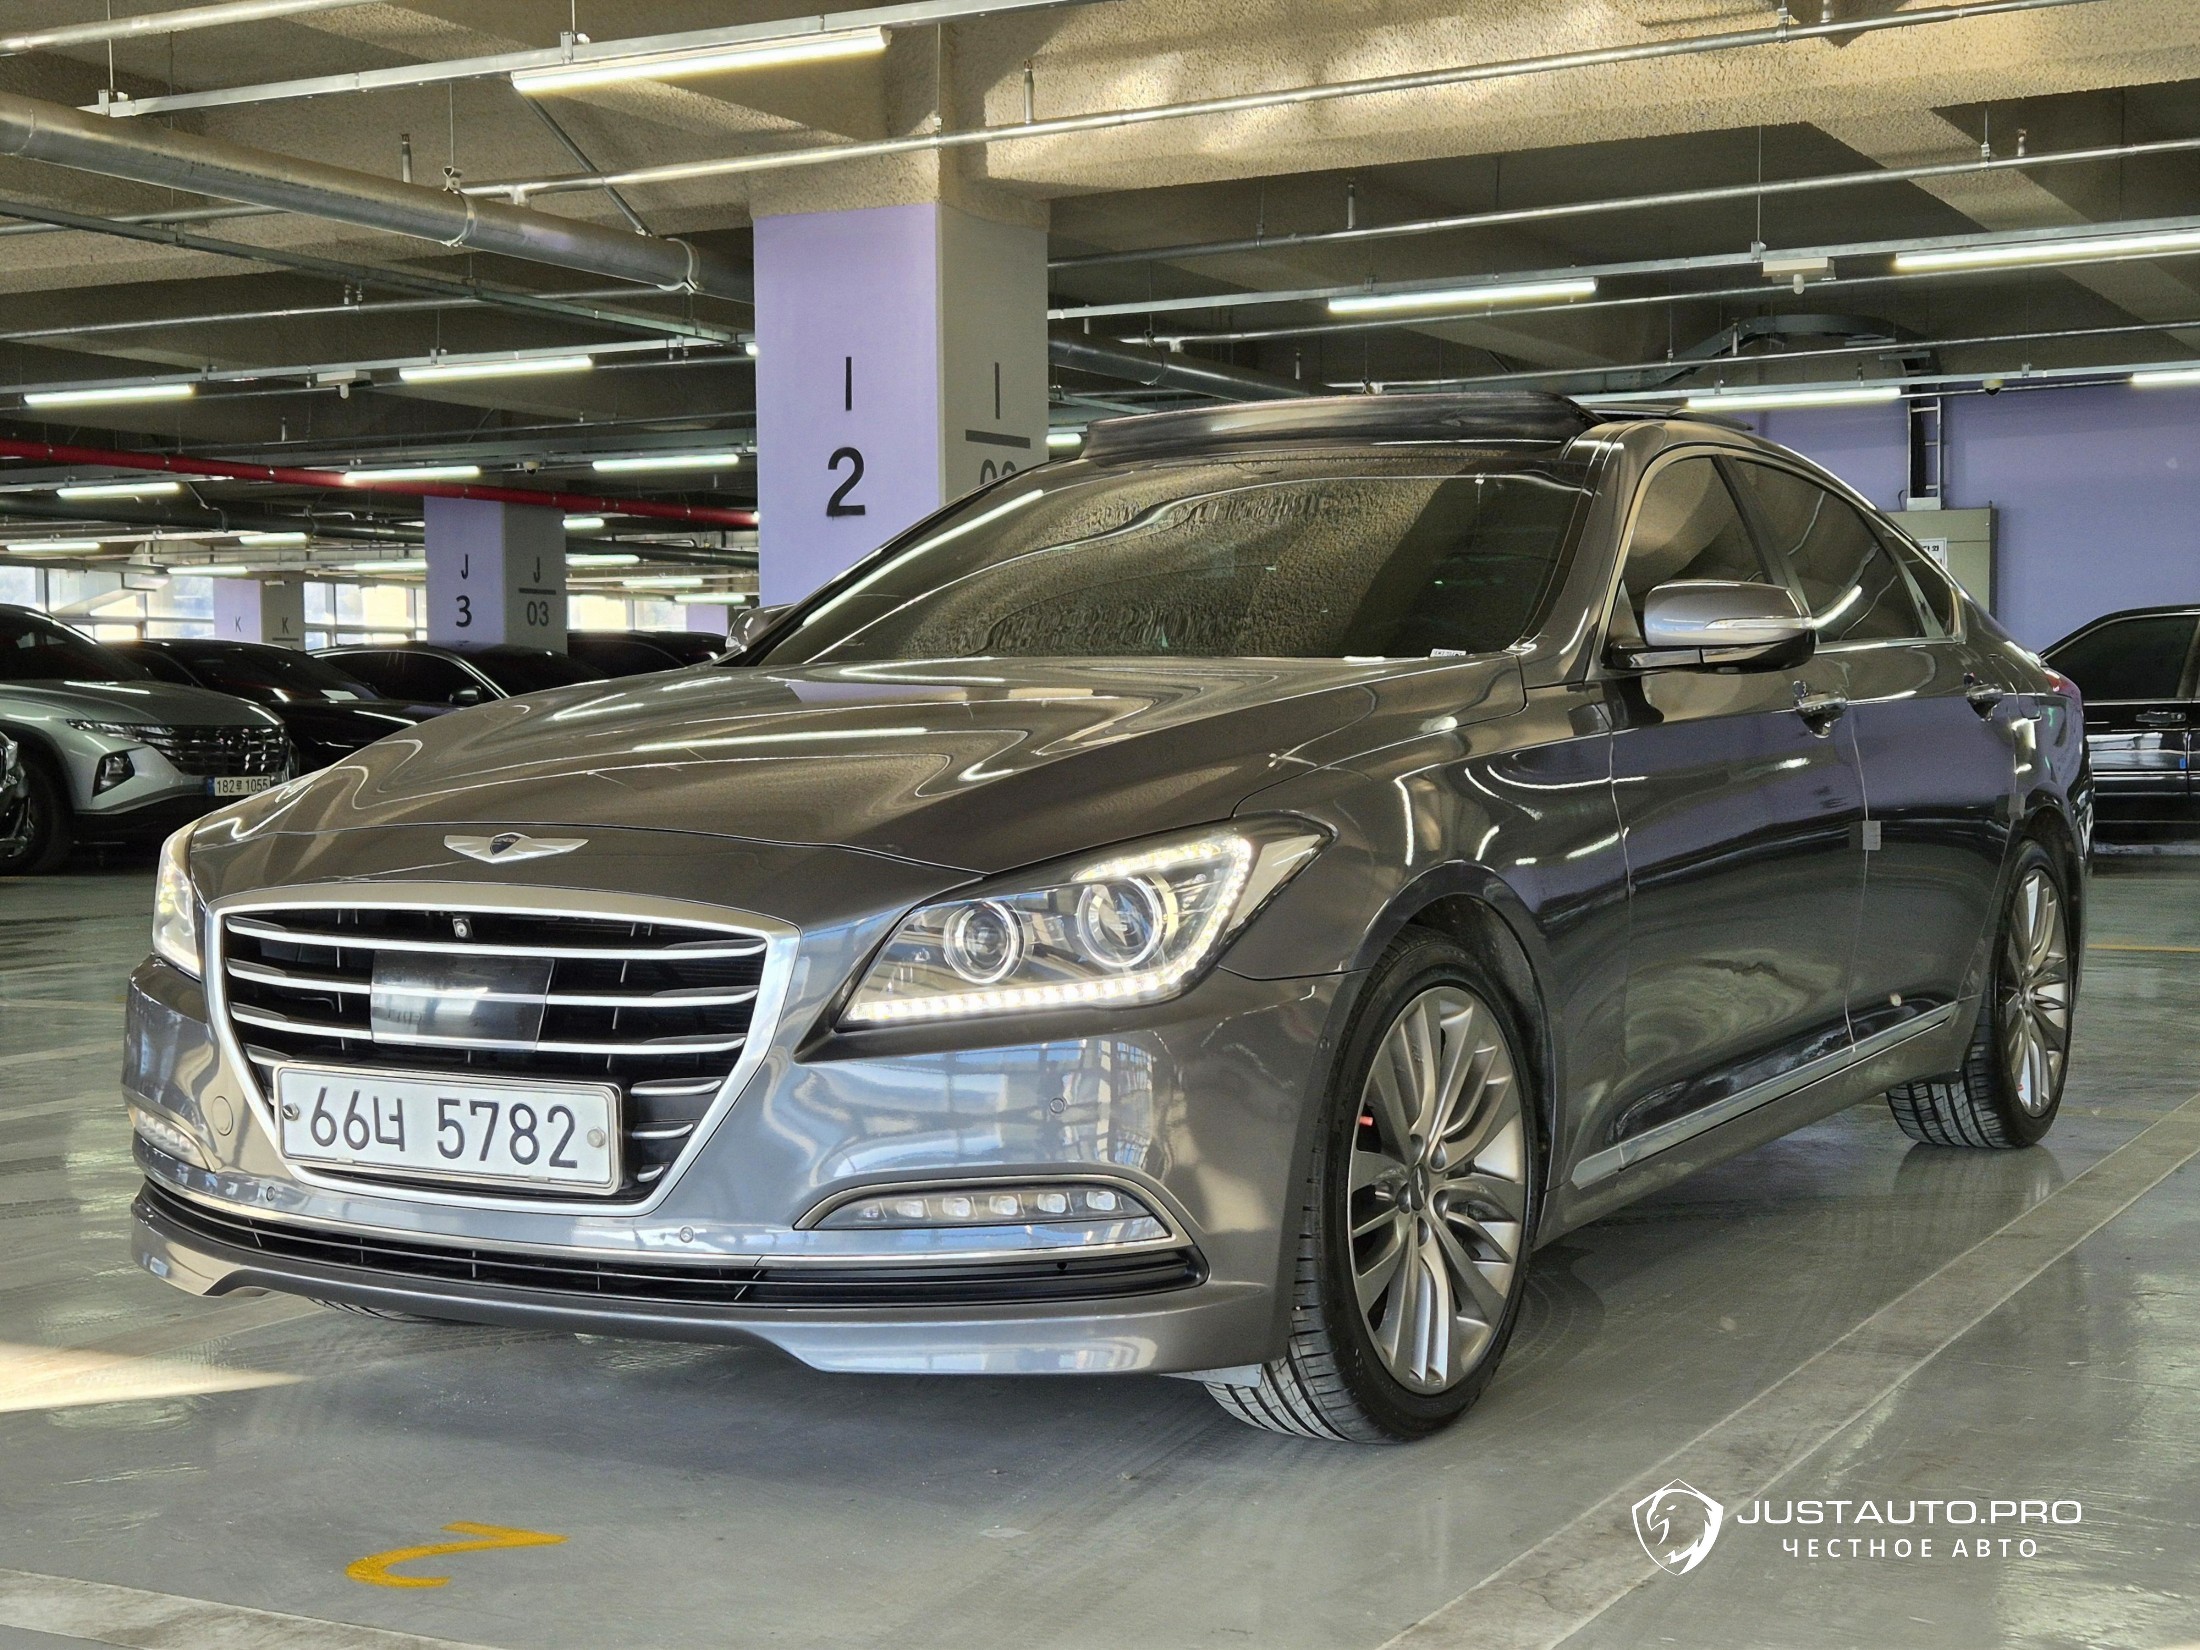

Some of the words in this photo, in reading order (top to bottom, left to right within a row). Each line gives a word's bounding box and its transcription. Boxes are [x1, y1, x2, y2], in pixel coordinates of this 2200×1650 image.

[826, 447, 865, 516] 2
[461, 554, 468, 579] J
[533, 557, 540, 583] J
[235, 616, 242, 632] K
[456, 595, 472, 627] 3
[526, 601, 549, 627] 03
[282, 617, 289, 634] K
[310, 1086, 405, 1152] 66너
[437, 1097, 578, 1169] 5782
